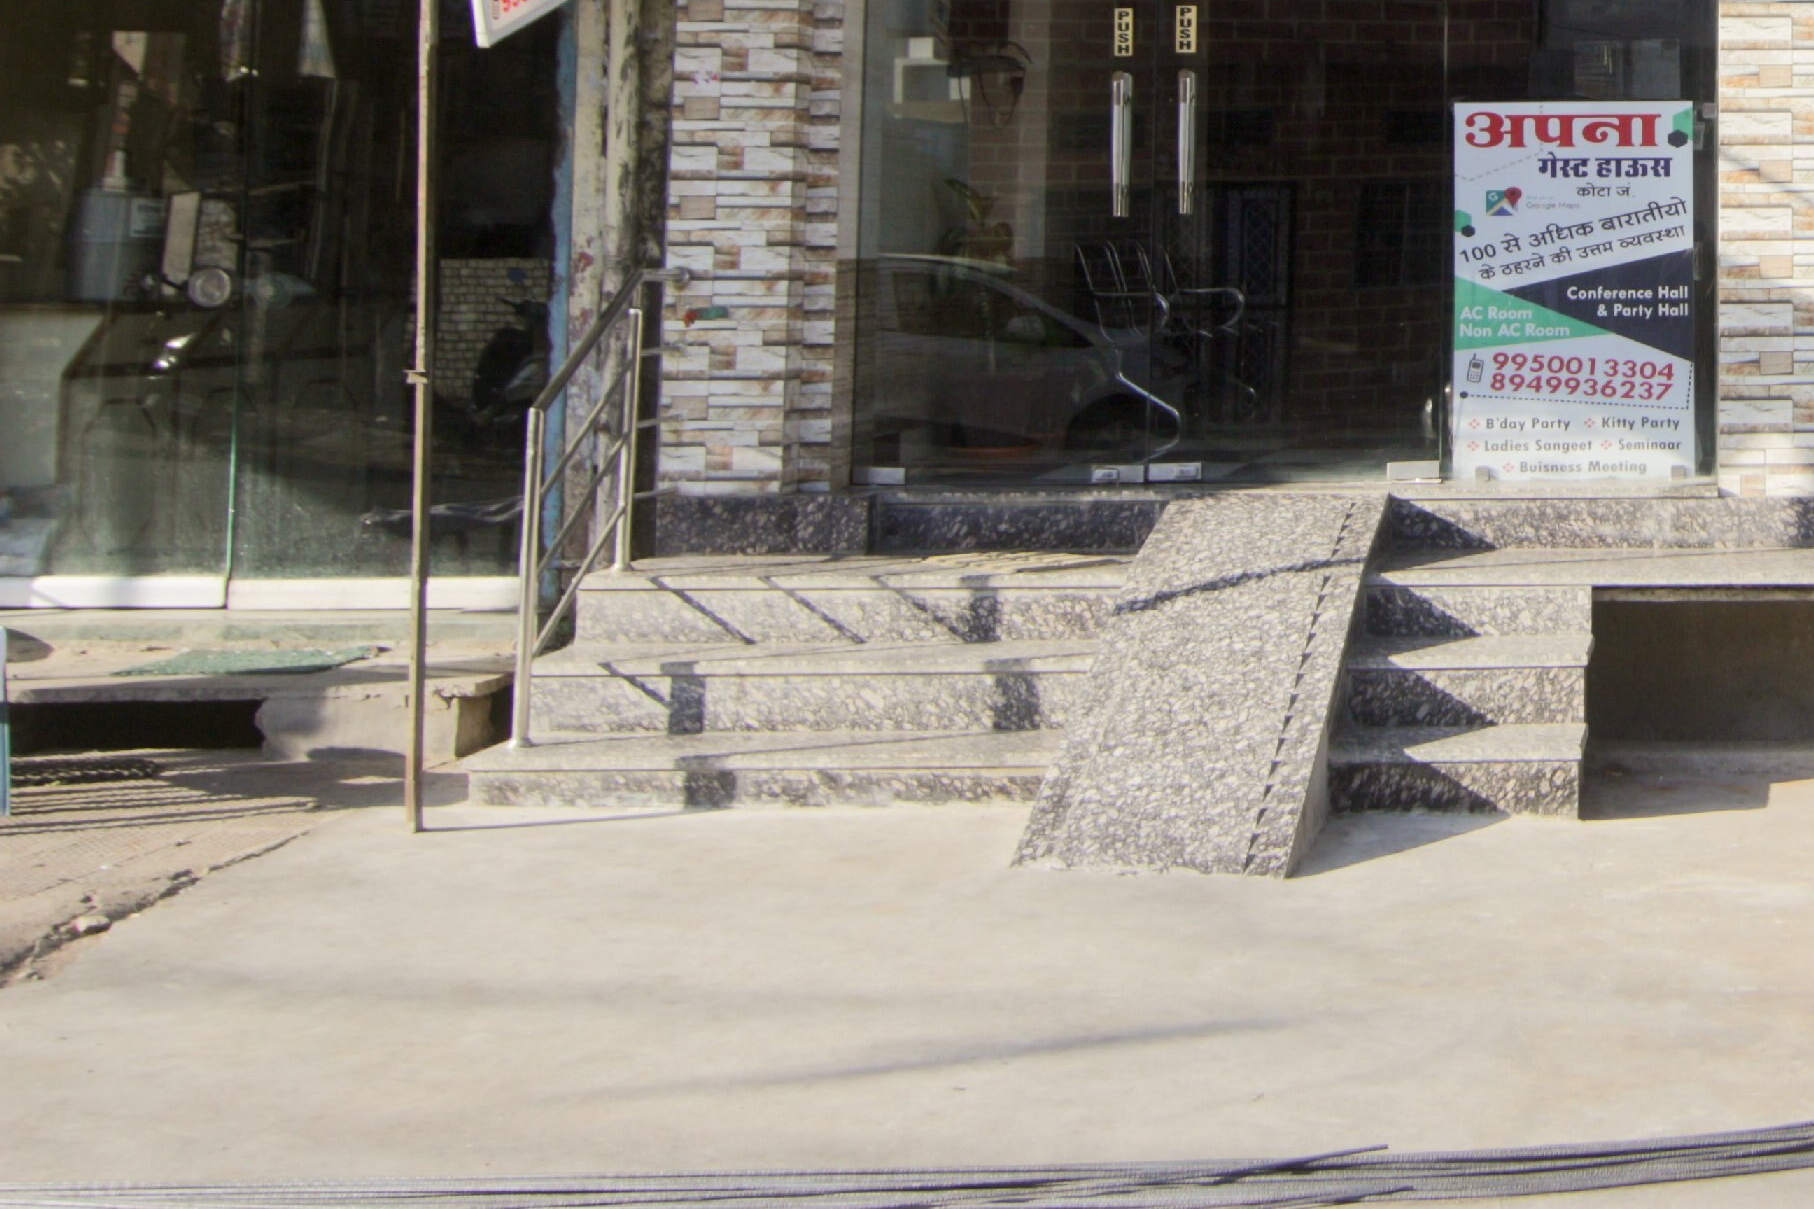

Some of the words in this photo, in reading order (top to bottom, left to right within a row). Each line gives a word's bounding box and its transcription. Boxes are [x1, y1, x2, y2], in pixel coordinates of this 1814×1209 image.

[1118, 10, 1130, 55] PUSH
[1179, 7, 1192, 50] PUSH
[1465, 111, 1662, 148] अपना
[1537, 151, 1590, 178] गेस्ट
[1595, 156, 1673, 178] हाऊस
[1576, 182, 1611, 197] कोटा
[1460, 243, 1497, 263] 100
[1501, 233, 1521, 254] से
[1528, 220, 1594, 247] अधिक
[1479, 263, 1496, 280] के
[1501, 252, 1546, 277] ठहरने
[1550, 246, 1572, 265] की
[1576, 240, 1613, 259] उत्तम
[1618, 225, 1685, 248] व्यवस्था
[1567, 286, 1653, 300] Conference
[1658, 285, 1688, 299] Hall
[1460, 307, 1483, 320] AC
[1487, 306, 1532, 319] Room
[1597, 304, 1607, 317] &
[1613, 303, 1652, 319] Party
[1658, 303, 1689, 317] Hall
[1459, 324, 1492, 337] Non
[1498, 323, 1521, 337] AC
[1525, 323, 1570, 337] Room
[1492, 352, 1674, 381] 9950013304
[1490, 372, 1673, 401] 8949936237
[1486, 418, 1525, 431] B'day
[1531, 417, 1570, 431] Party
[1601, 416, 1635, 431] Kitty
[1641, 416, 1680, 431] Party
[1484, 439, 1529, 452] Ladies
[1535, 439, 1593, 454] Sangeet
[1618, 439, 1682, 450] Seminaar
[1519, 460, 1582, 473] Buisness
[1588, 460, 1647, 475] Meeting
